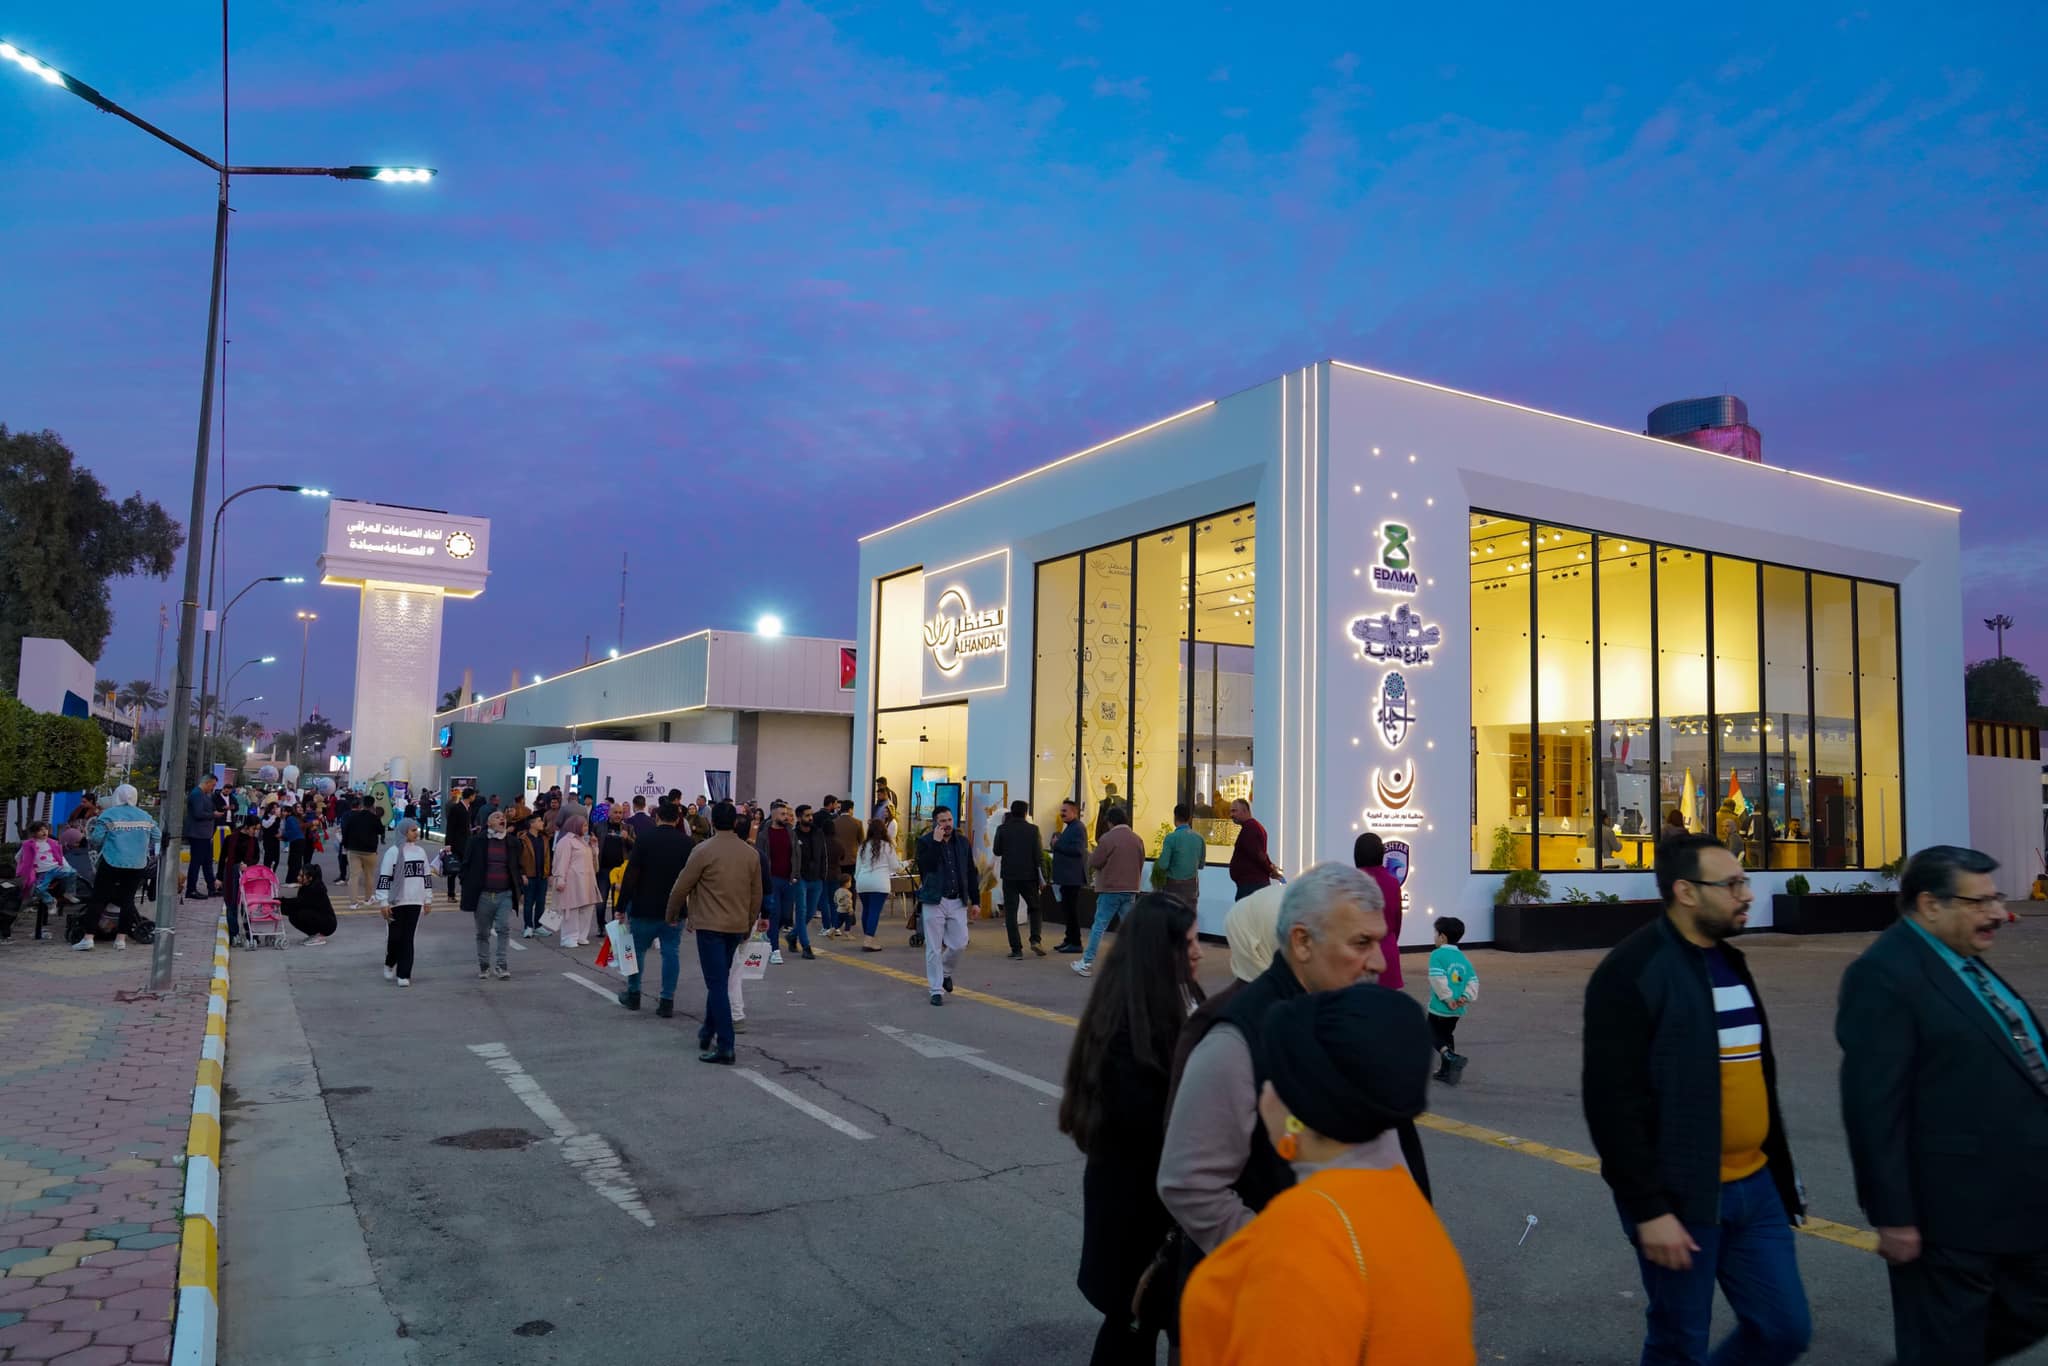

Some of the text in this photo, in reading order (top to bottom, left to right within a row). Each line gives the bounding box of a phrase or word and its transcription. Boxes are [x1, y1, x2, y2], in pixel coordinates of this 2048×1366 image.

[382, 525, 423, 539] الصناعات
[1373, 567, 1418, 586] EDAMA
[954, 634, 1004, 657] ALHANDAL
[1365, 641, 1430, 665] مزارع هادية
[634, 785, 666, 795] CAPITANO
[1384, 842, 1408, 853] SHTAR
